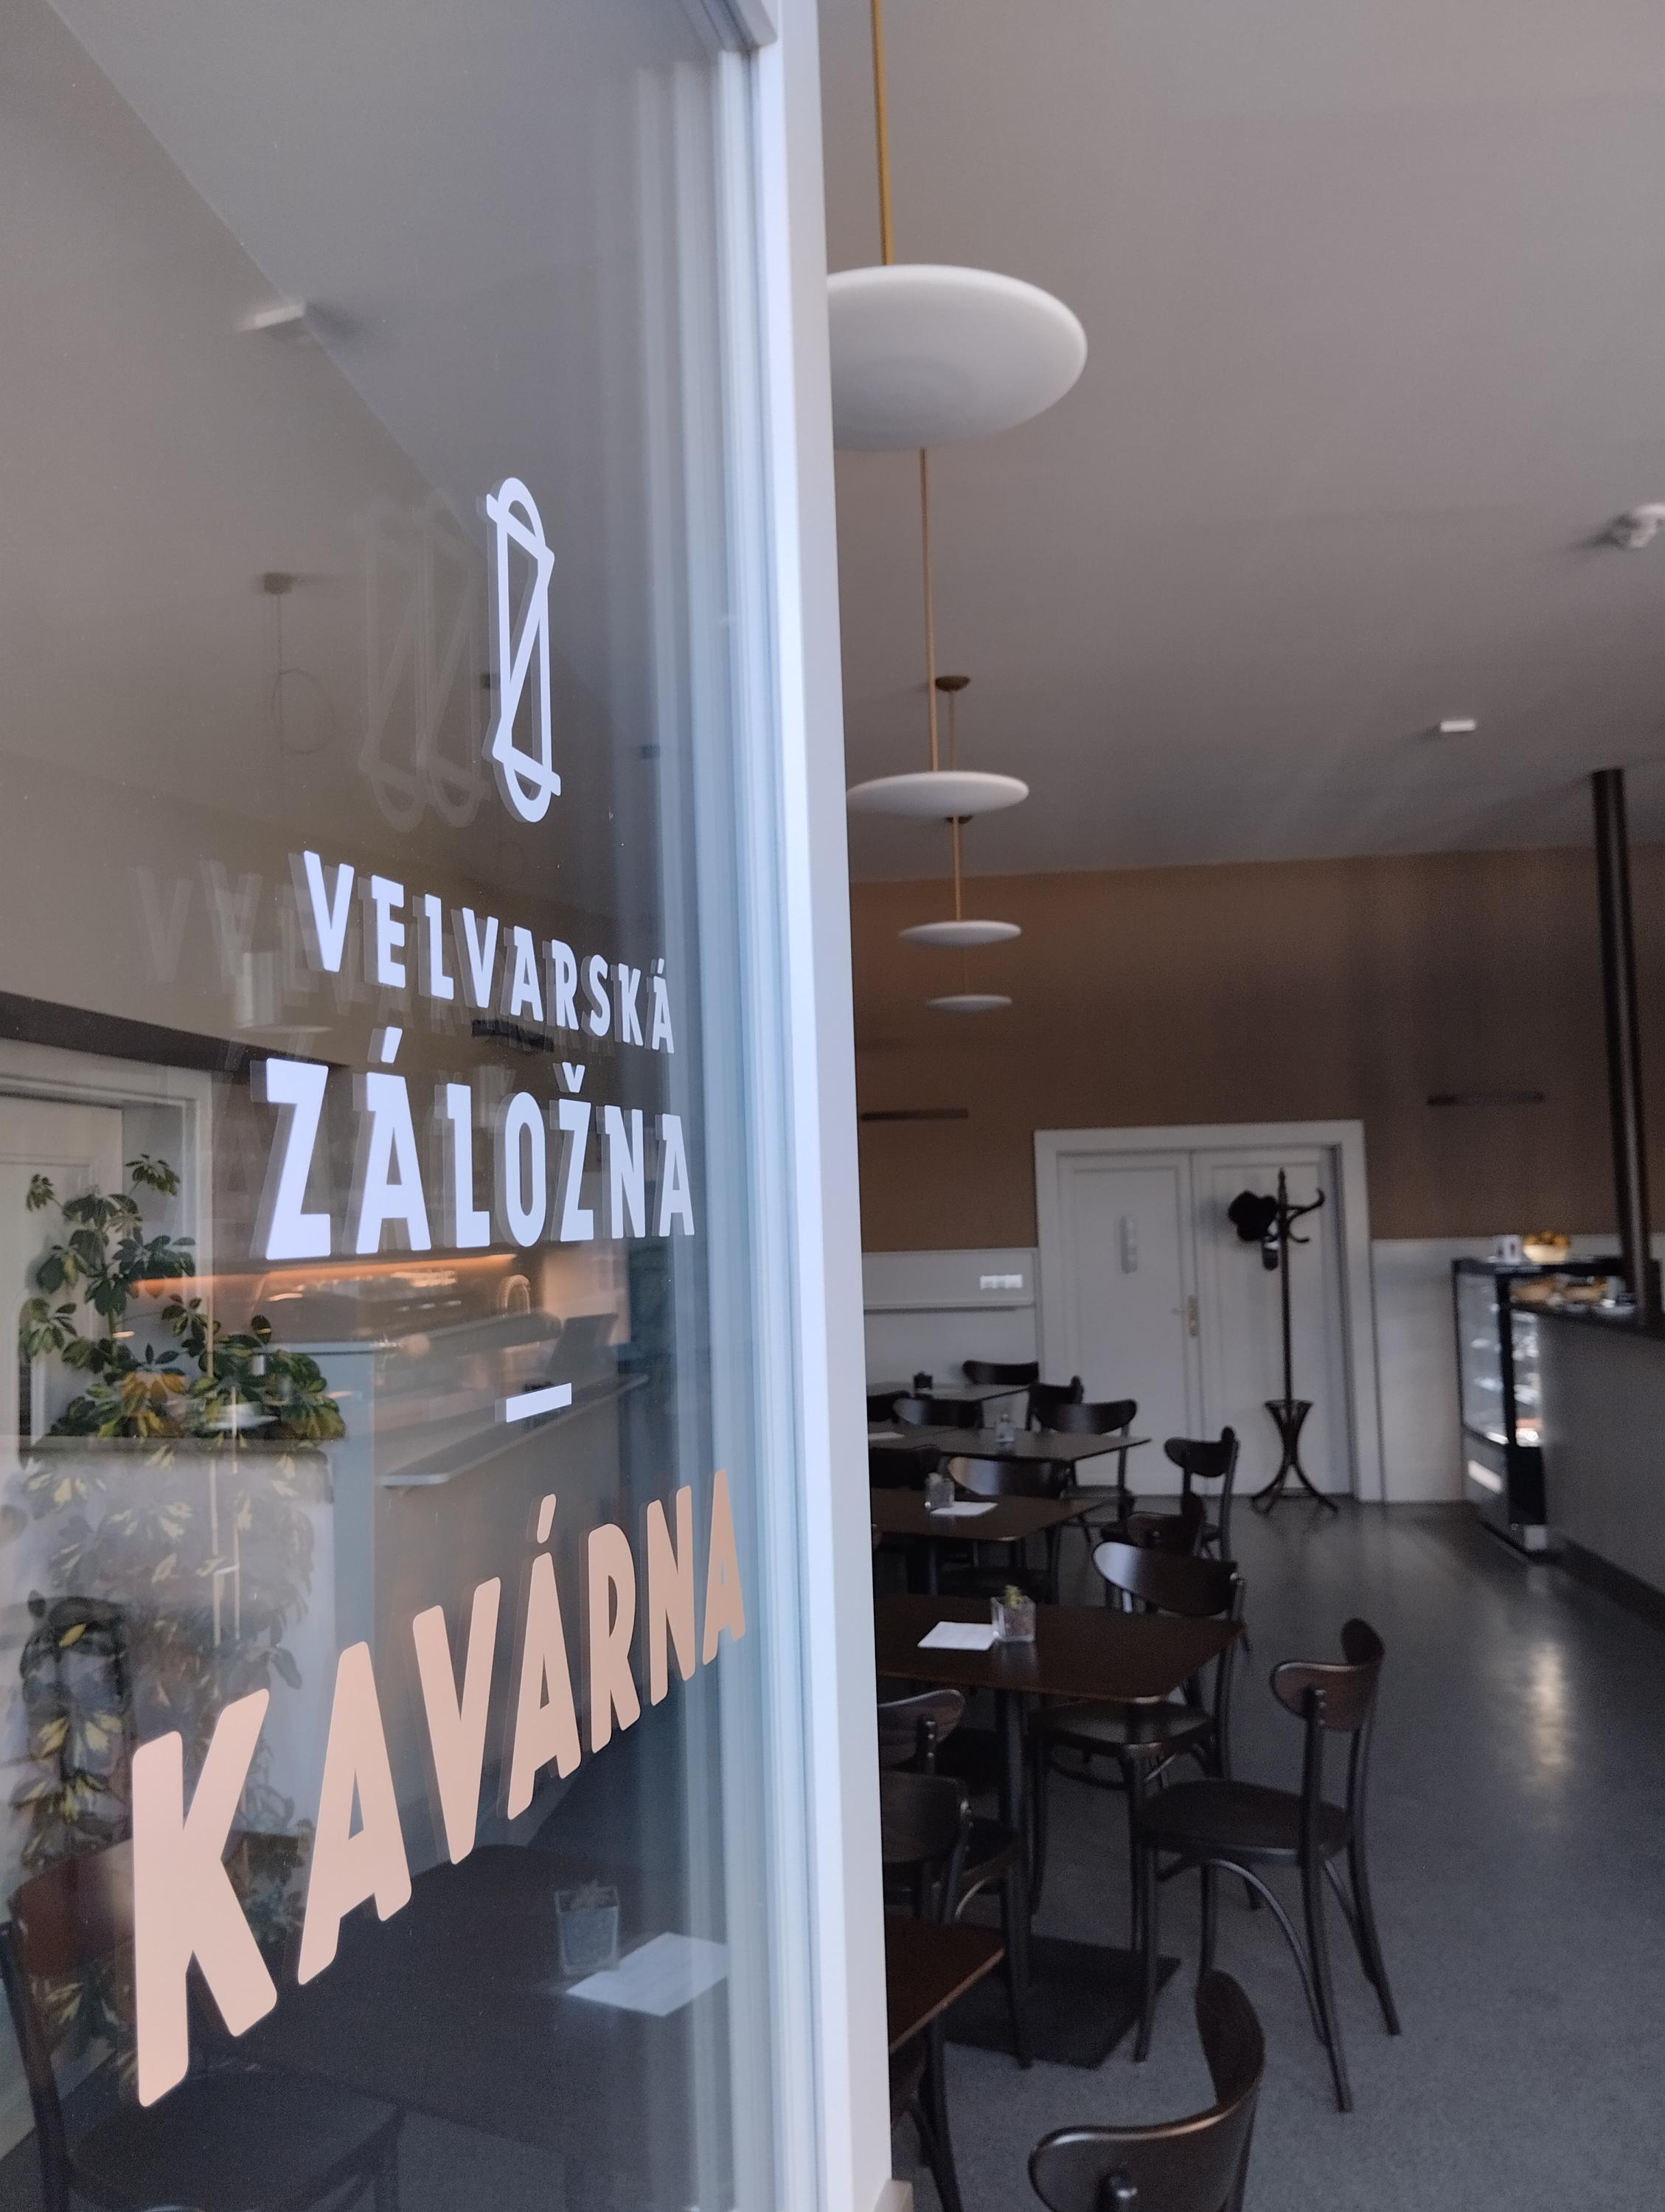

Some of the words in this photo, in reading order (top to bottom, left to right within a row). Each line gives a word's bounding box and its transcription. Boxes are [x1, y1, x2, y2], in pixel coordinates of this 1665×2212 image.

[303, 850, 675, 1053] VELVARSKÁ
[265, 1026, 695, 1260] ZÁLOŽNA
[133, 1470, 746, 2107] KAVÁRNA
